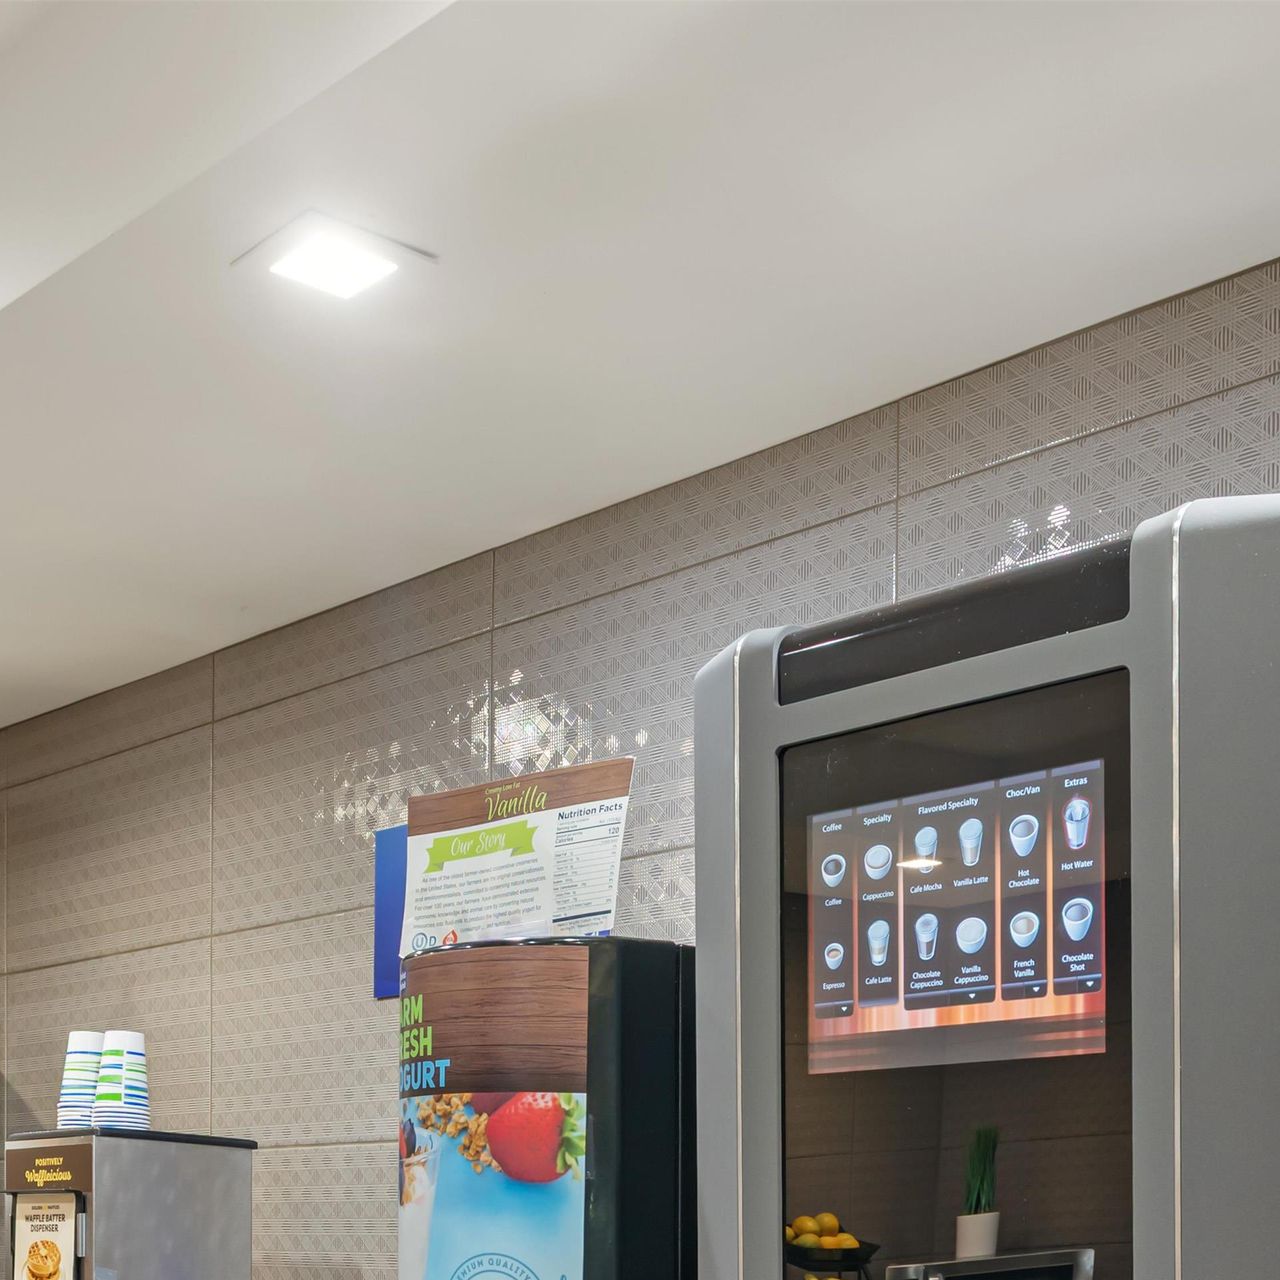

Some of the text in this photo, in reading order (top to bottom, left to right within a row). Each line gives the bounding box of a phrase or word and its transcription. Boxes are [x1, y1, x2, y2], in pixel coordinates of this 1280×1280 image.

[1064, 776, 1088, 788] Extras
[1006, 785, 1040, 798] Choc/Van
[484, 784, 550, 820] Vanilla
[918, 796, 978, 815] Flavored Specialty
[558, 802, 624, 820] Nutrition Facts
[862, 812, 892, 826] Specialty
[608, 826, 620, 835] 120
[822, 822, 842, 834] Coffee
[450, 830, 506, 856] Our Story
[554, 836, 574, 844] Calories
[1061, 859, 1094, 871] Hot Water
[1018, 868, 1030, 878] Hot
[953, 875, 989, 888] Vanilla Latte
[1008, 878, 1040, 888] Chocolate
[910, 882, 943, 894] Cafe Mocha
[862, 890, 894, 902] Cappuccino
[824, 898, 842, 907] Coffee
[1061, 952, 1094, 963] Chocolate
[1013, 958, 1035, 968] French
[1070, 963, 1085, 972] Shot
[960, 965, 982, 974] Vanilla
[1013, 968, 1035, 978] Vanilla
[912, 970, 942, 980] Chocolate
[954, 974, 989, 986] Cappuccino
[865, 976, 892, 986] Cafe Latte
[910, 978, 944, 990] Cappuccino
[822, 982, 846, 991] Espresso
[35, 1156, 64, 1166] POSITIVELY
[24, 1214, 66, 1223] WAFFLE BATTER
[30, 1224, 59, 1233] DISPENSER
